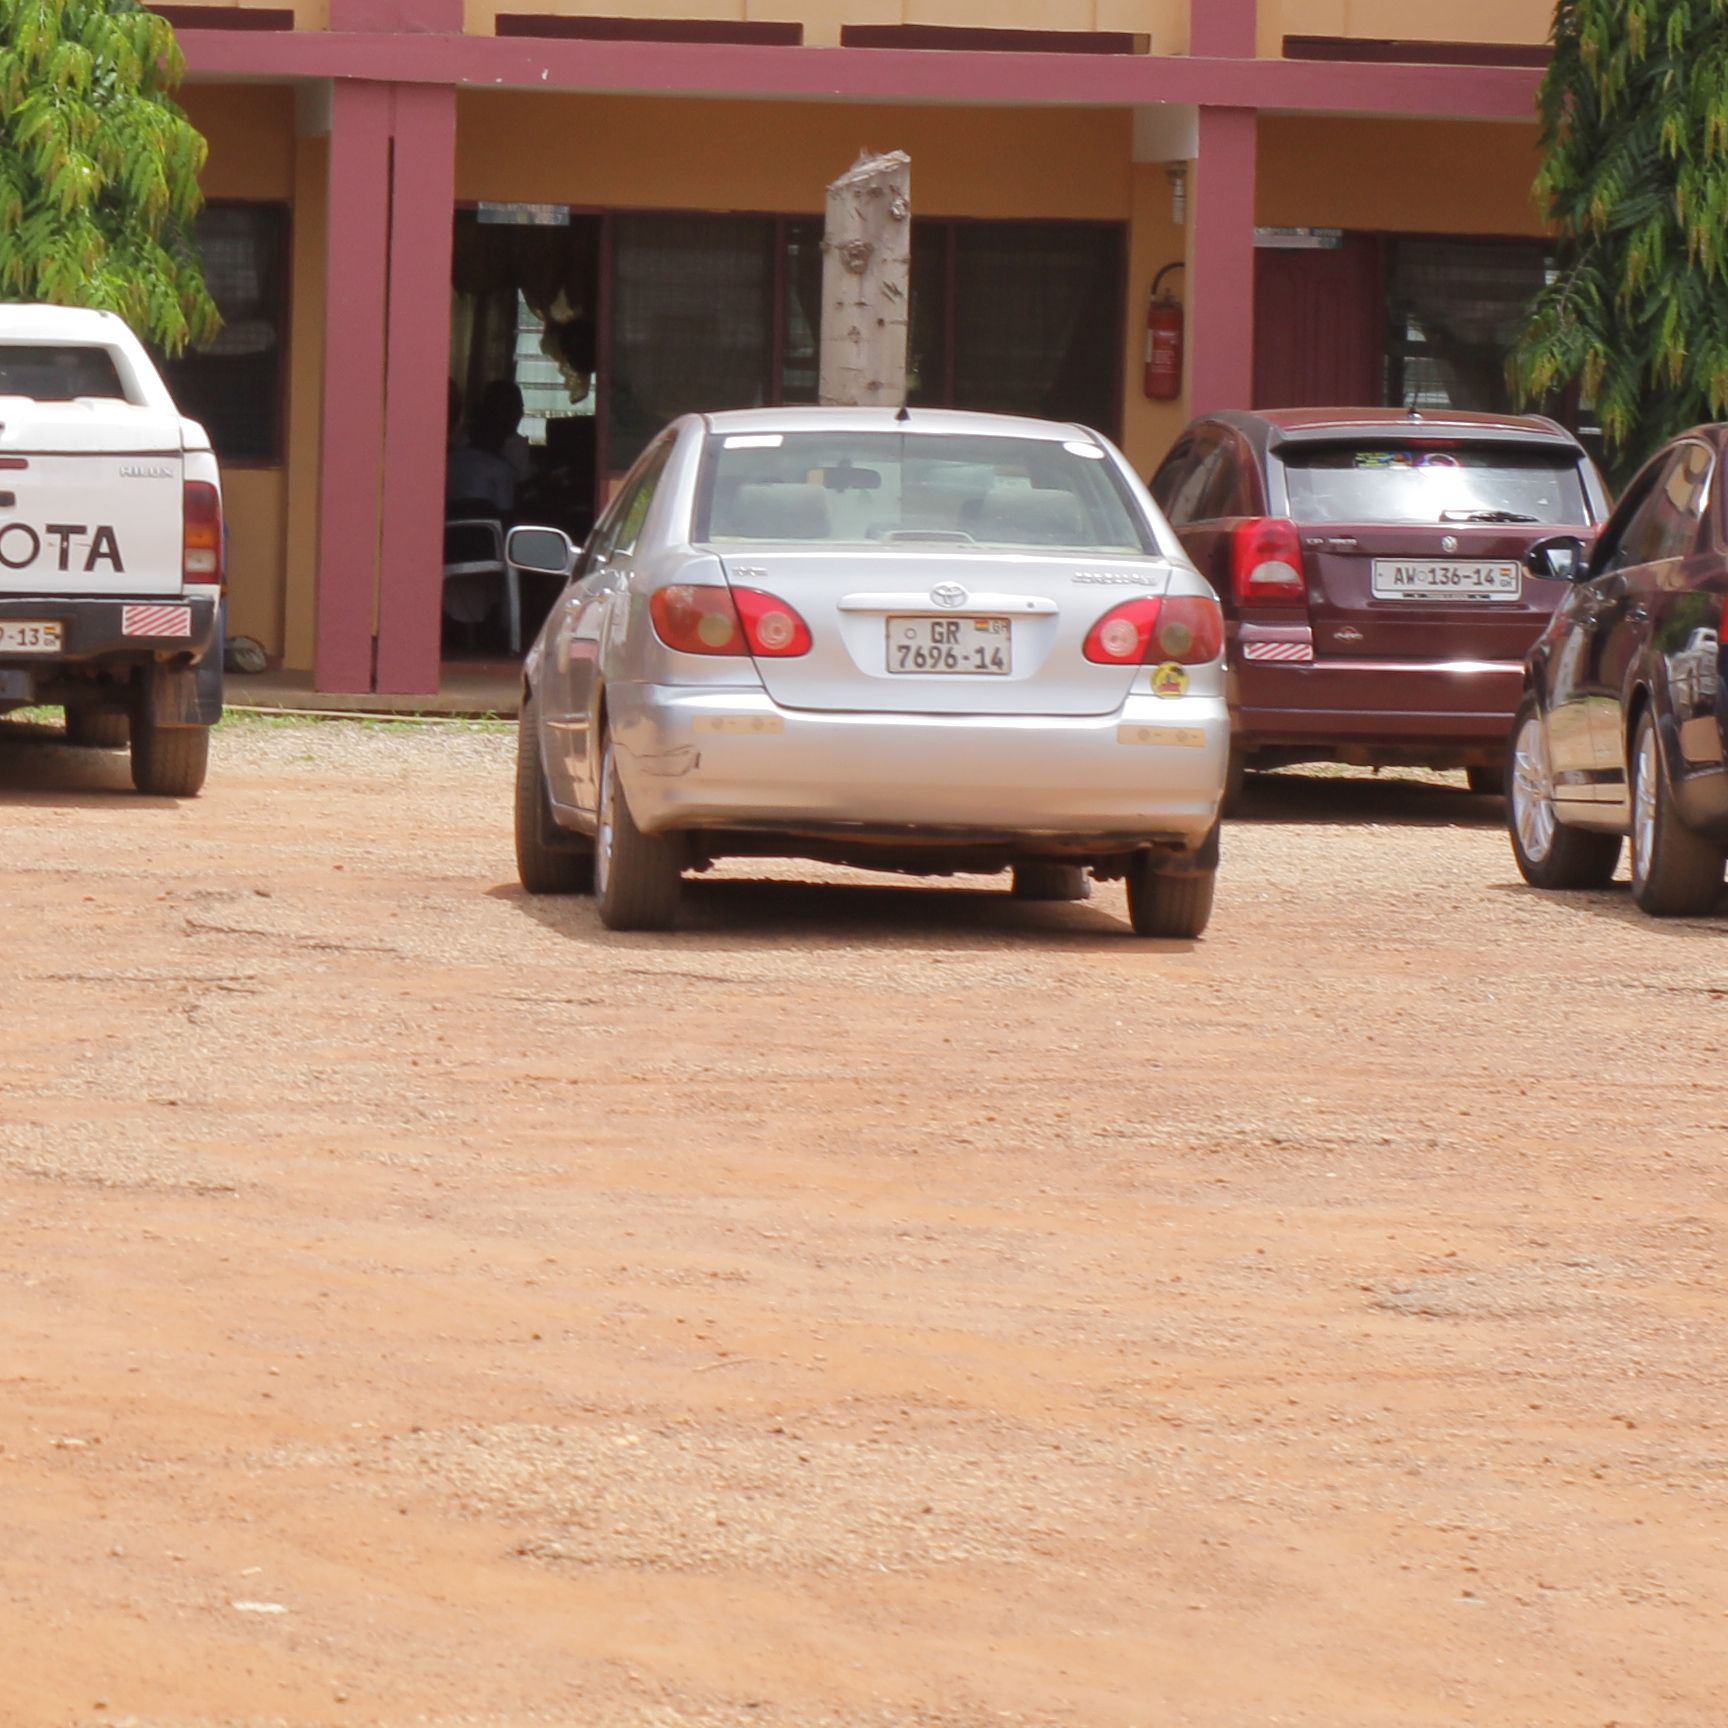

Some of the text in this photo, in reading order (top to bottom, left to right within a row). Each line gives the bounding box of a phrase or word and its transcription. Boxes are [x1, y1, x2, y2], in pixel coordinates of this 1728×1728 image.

[1393, 567, 1496, 586] AW 136-14
[930, 621, 961, 644] GR
[896, 644, 1005, 671] 7696-14
